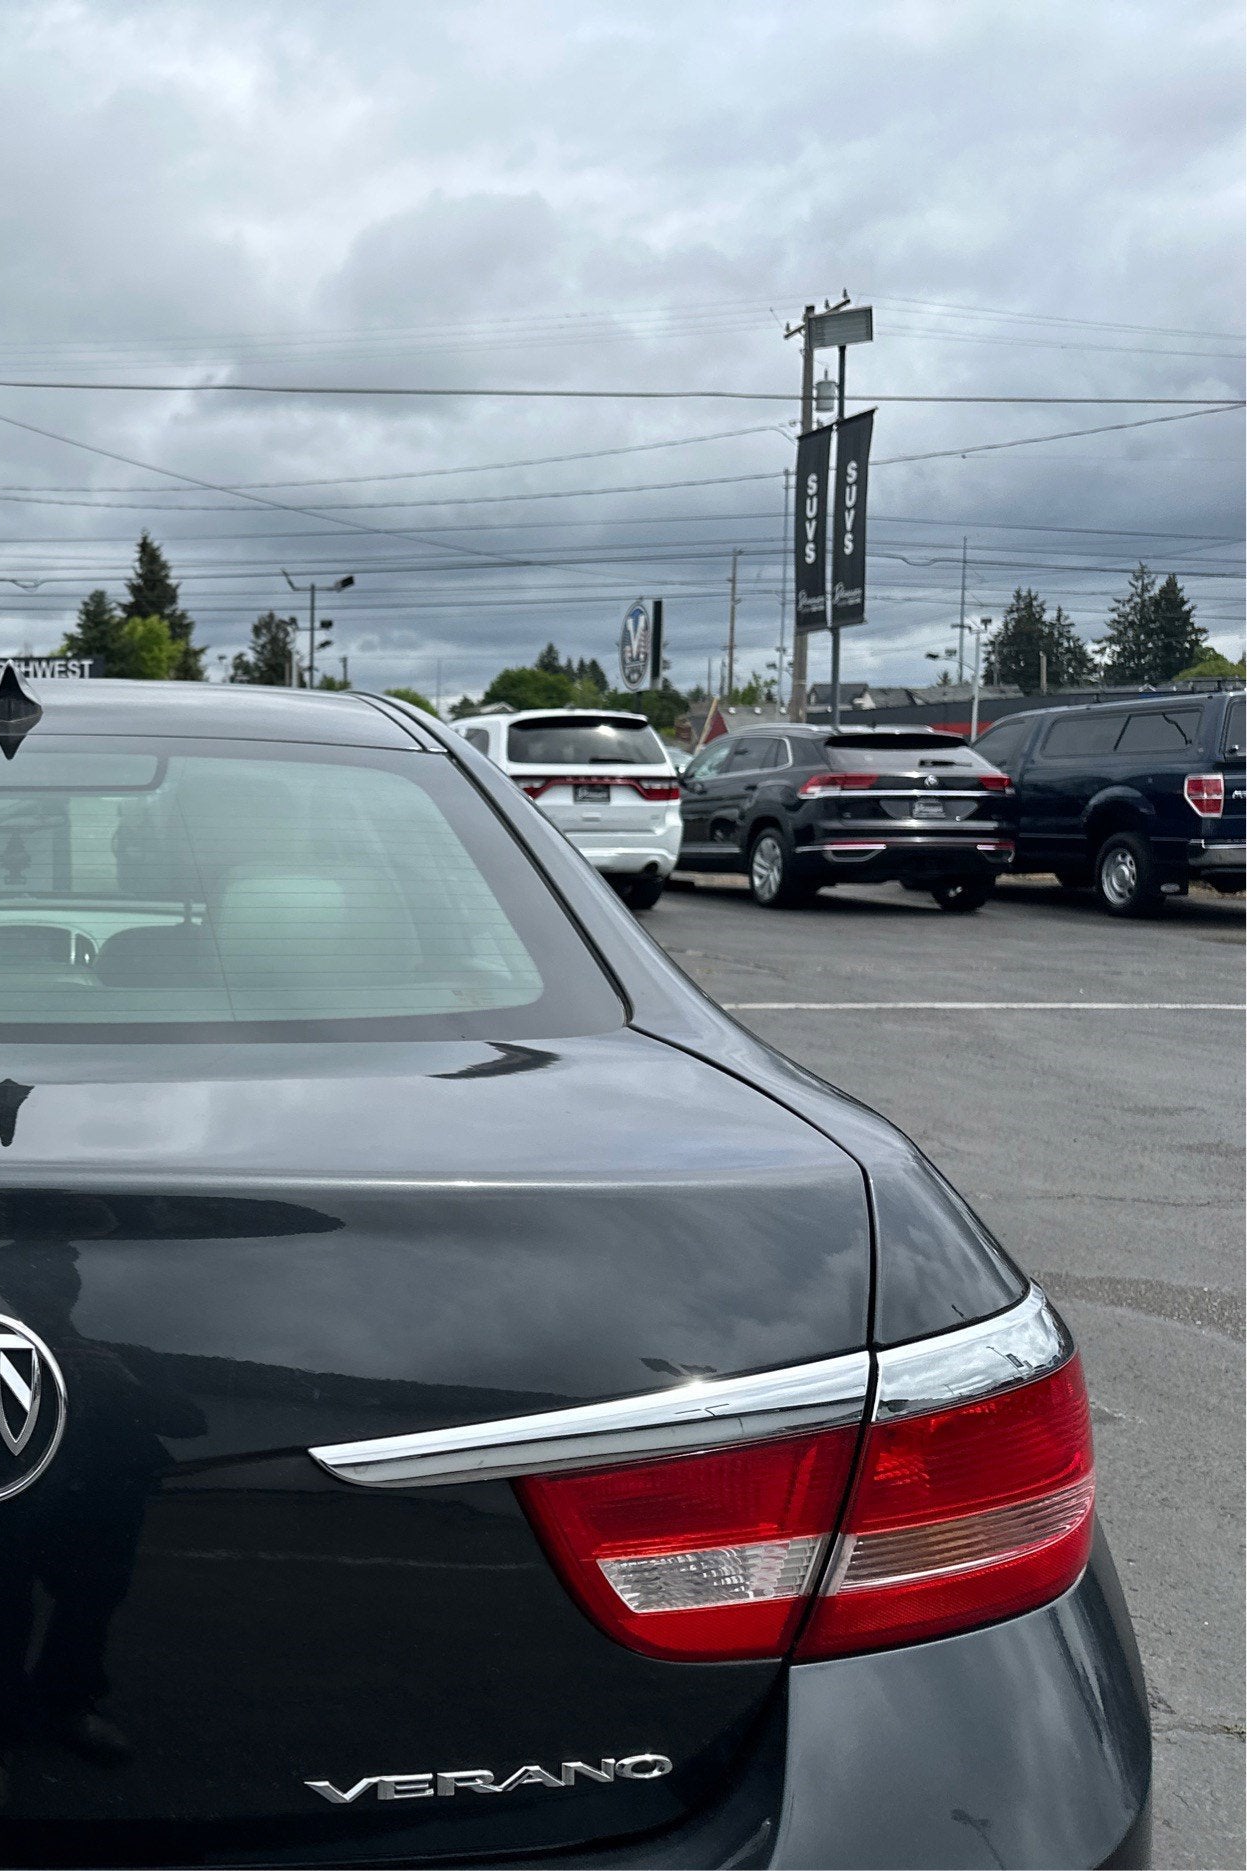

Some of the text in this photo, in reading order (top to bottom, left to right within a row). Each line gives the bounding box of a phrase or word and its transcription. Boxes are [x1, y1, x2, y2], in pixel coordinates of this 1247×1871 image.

[805, 473, 818, 565] SUVS
[844, 460, 859, 556] SUVS
[302, 1753, 674, 1803] VERANO
